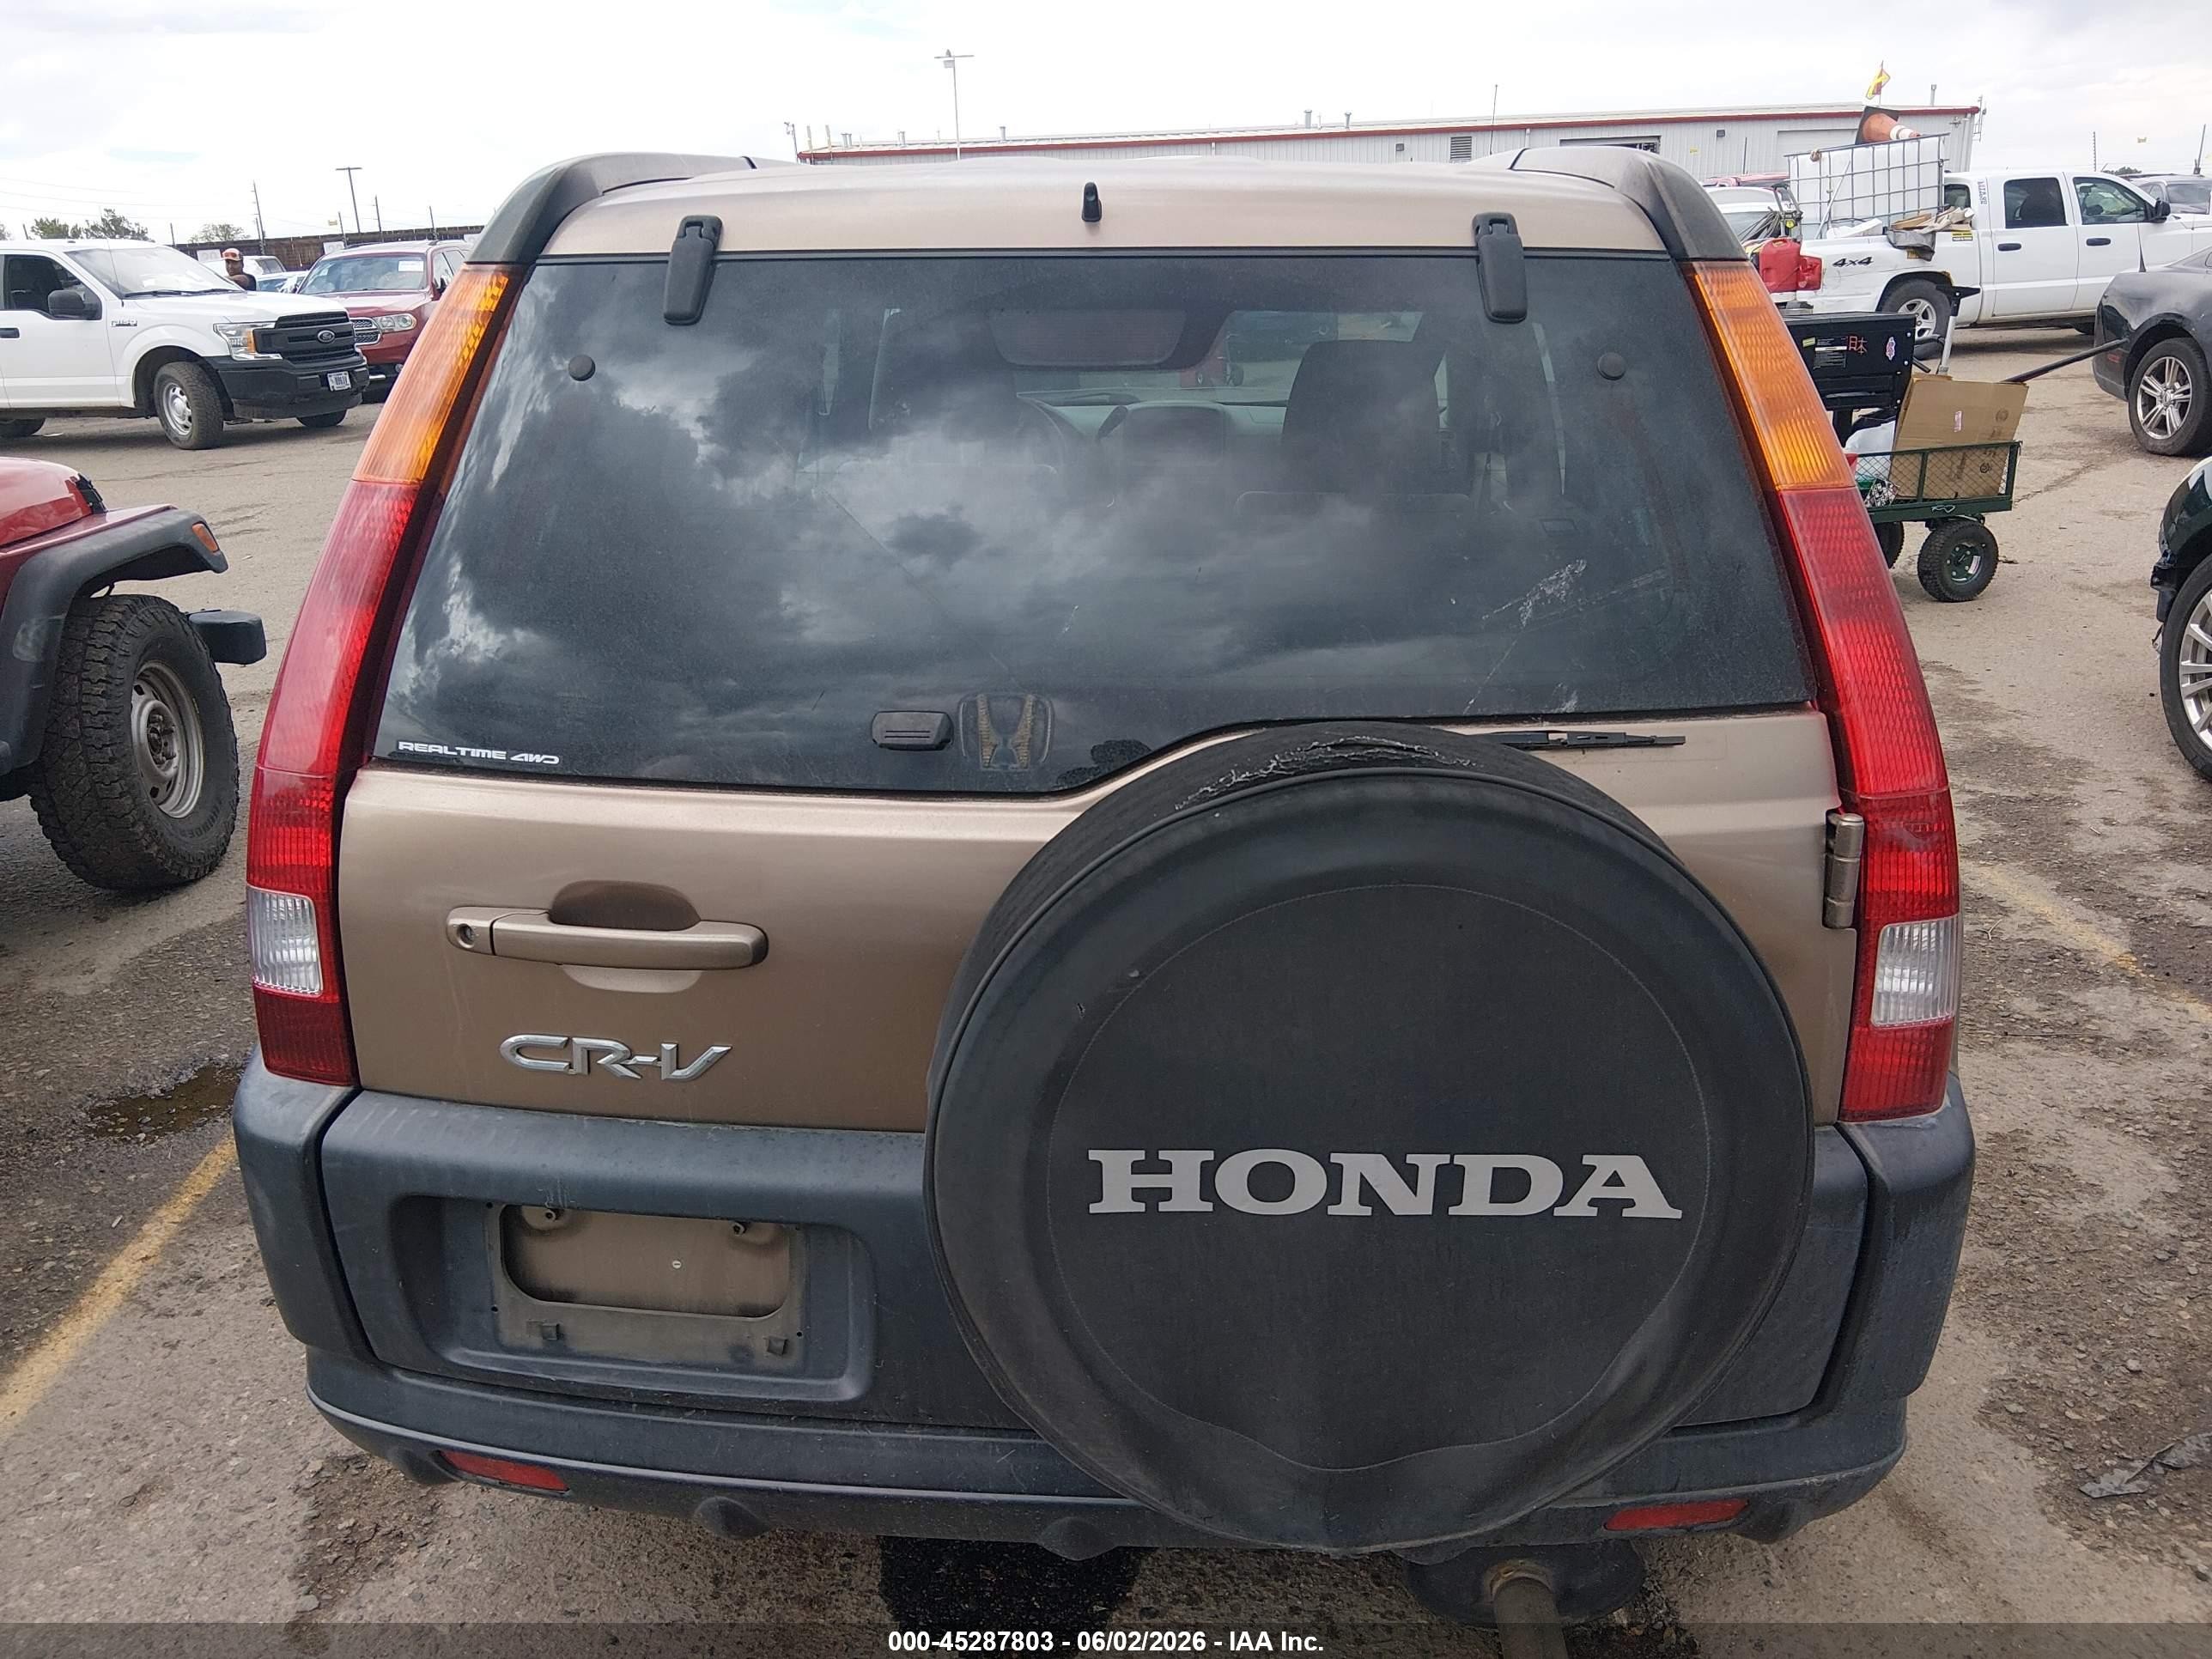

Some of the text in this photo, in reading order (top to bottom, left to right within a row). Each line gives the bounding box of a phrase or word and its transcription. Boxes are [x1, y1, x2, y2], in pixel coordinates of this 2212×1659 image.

[1832, 257, 1874, 267] 4x4
[510, 752, 560, 765] 4WD
[500, 1034, 732, 1081] CR-V
[1087, 1148, 1683, 1219] HONDA
